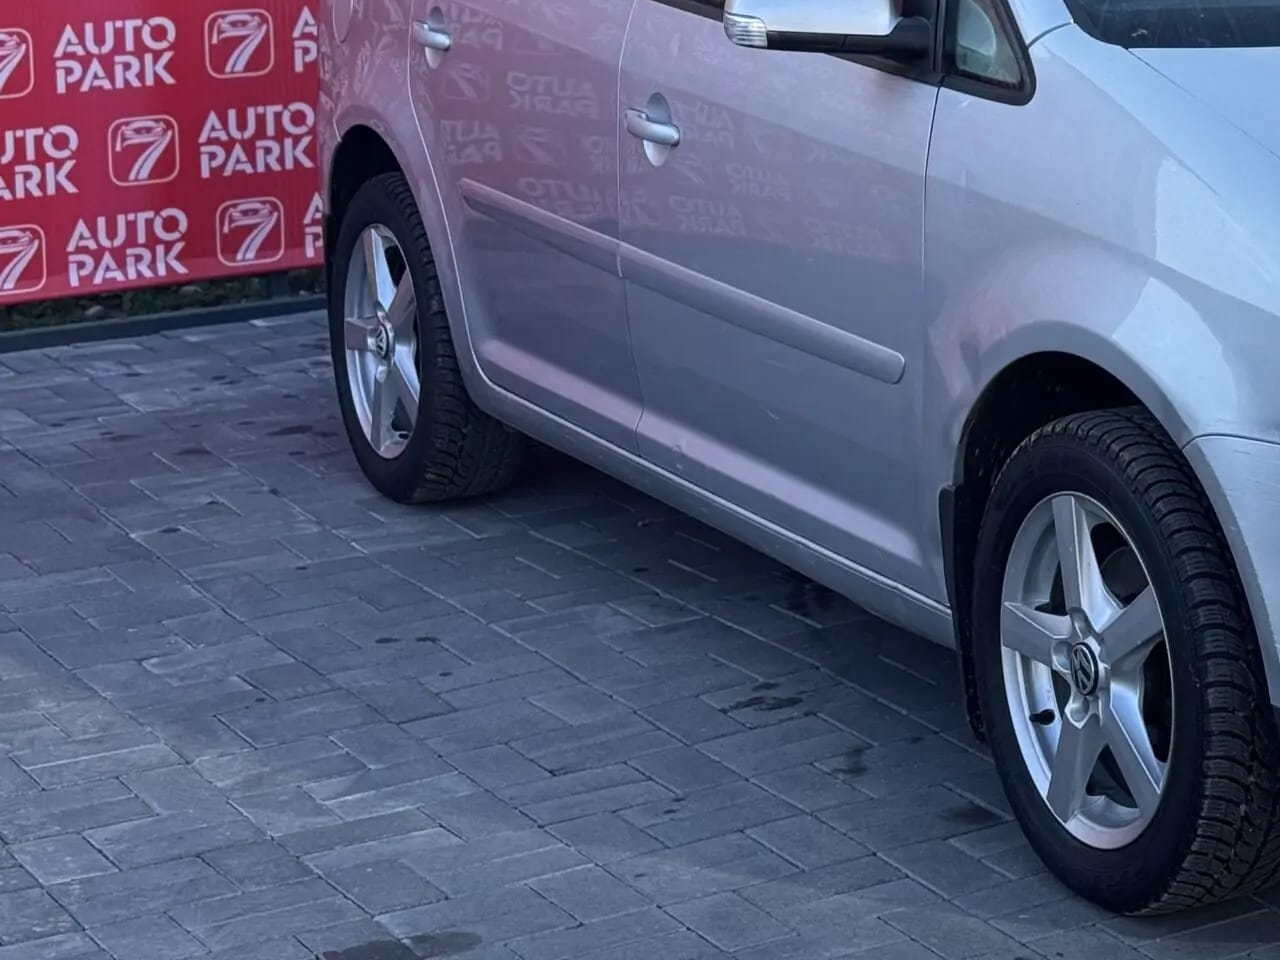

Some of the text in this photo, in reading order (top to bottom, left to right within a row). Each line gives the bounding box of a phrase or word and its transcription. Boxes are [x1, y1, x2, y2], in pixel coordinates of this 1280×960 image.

[53, 16, 176, 58] AUTO
[55, 51, 176, 94] PARK
[199, 101, 314, 143] AUTO
[200, 136, 314, 178] PARK
[66, 207, 188, 251] AUTO
[68, 242, 189, 287] PARK
